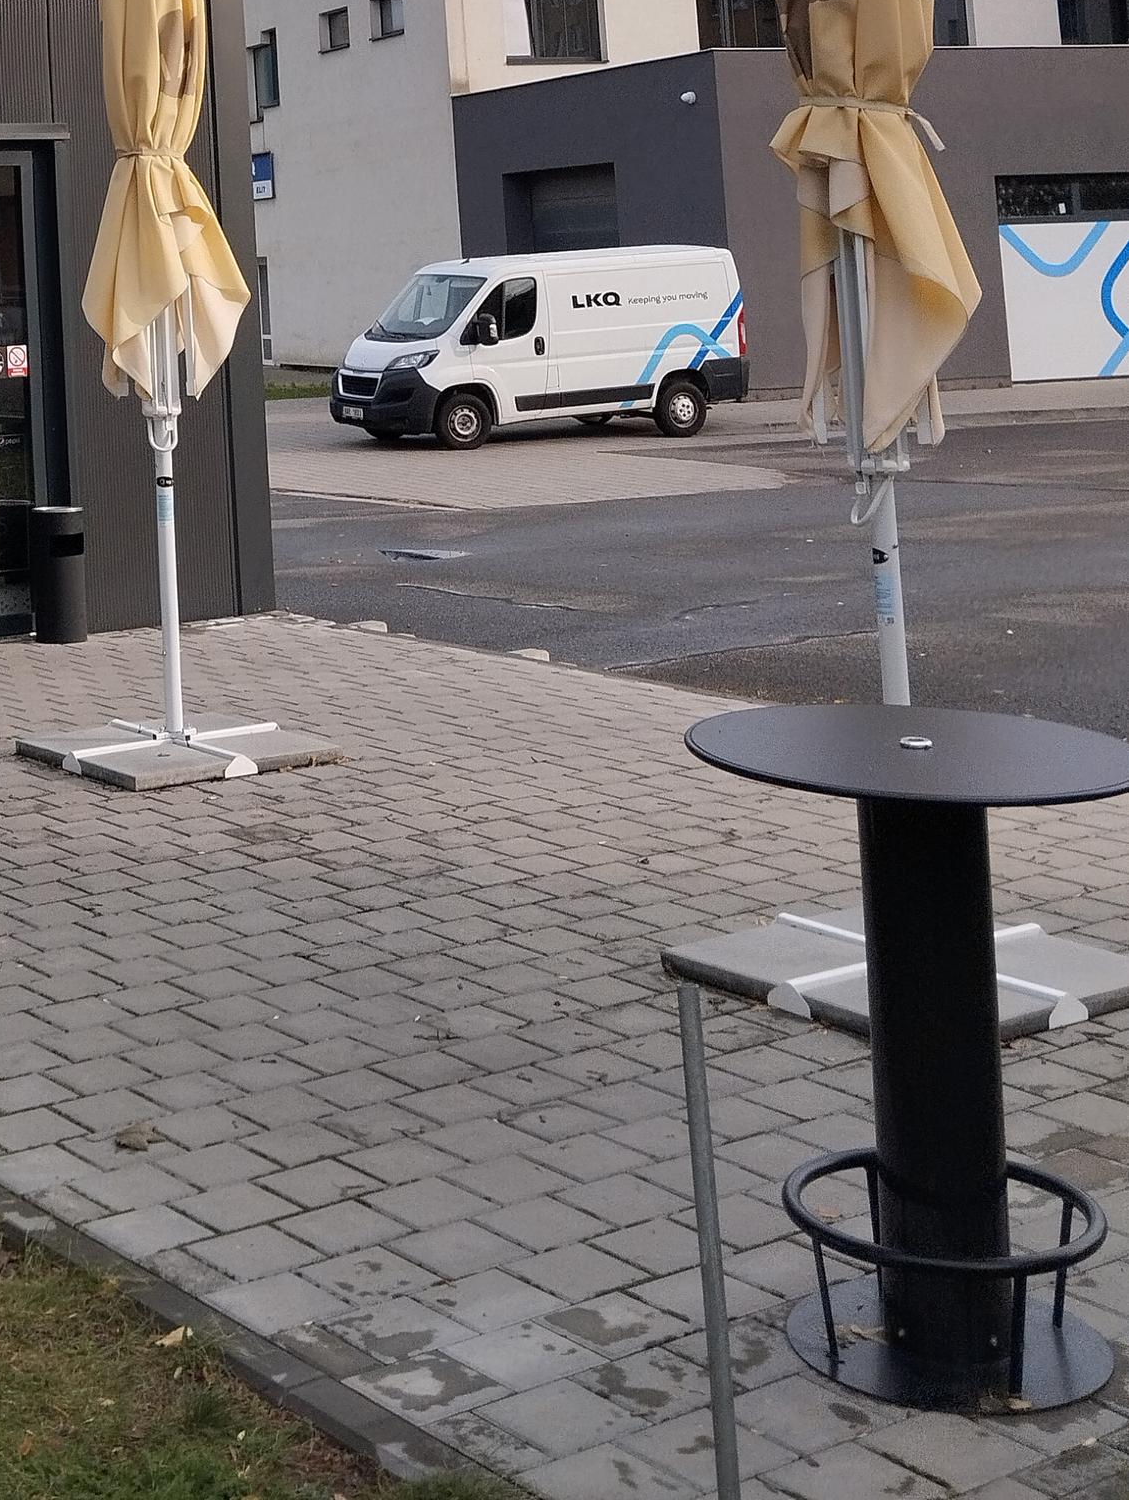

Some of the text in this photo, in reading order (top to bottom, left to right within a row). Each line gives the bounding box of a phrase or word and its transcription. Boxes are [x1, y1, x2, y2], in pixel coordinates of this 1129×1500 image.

[571, 291, 623, 309] LKQ
[662, 293, 677, 303] you
[679, 291, 709, 301] moving
